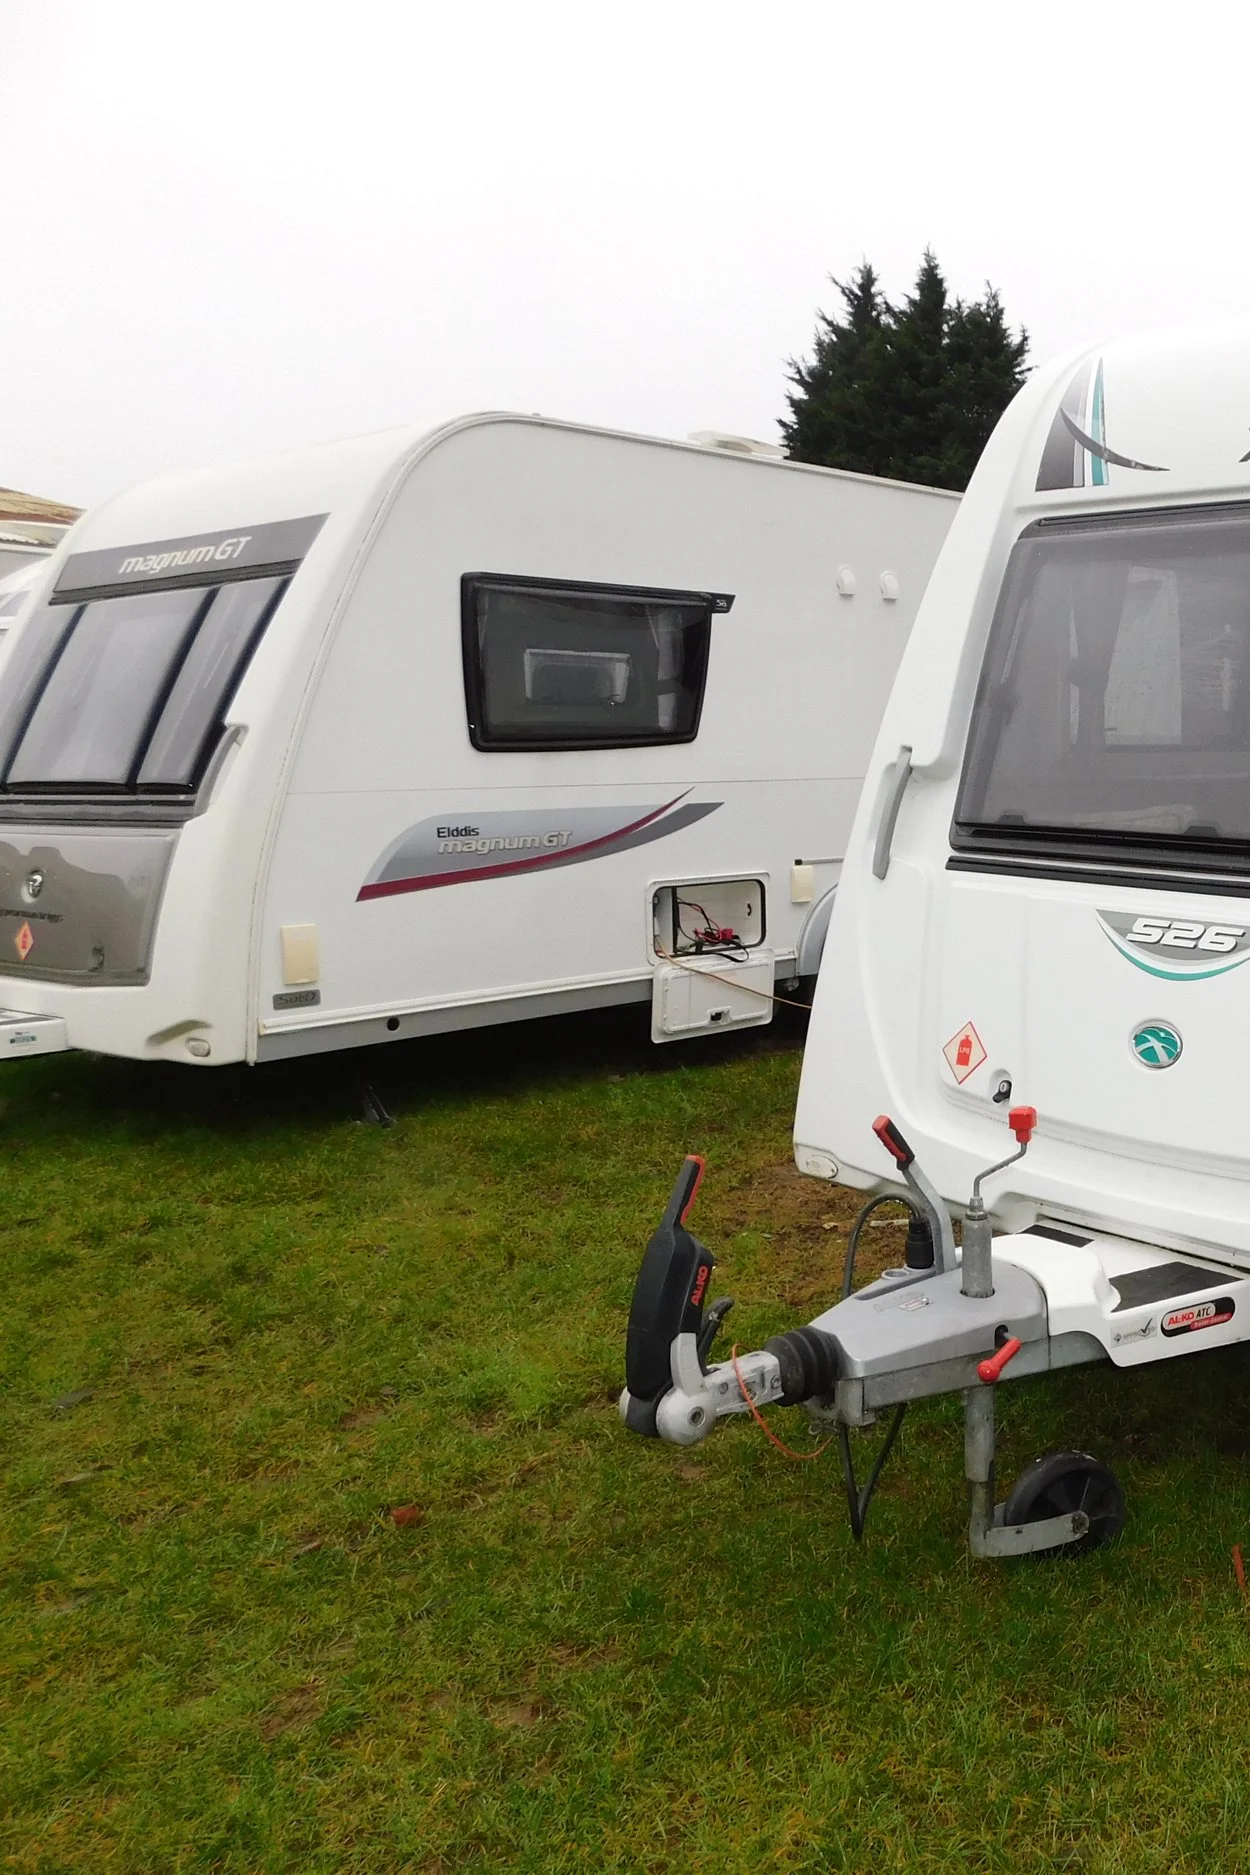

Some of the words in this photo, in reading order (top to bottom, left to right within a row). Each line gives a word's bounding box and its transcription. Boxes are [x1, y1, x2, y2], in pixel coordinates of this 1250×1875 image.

[437, 826, 480, 838] Elddis
[1125, 917, 1246, 954] 526
[1167, 1311, 1194, 1326] AL-KO
[1196, 1307, 1211, 1319] ATC
